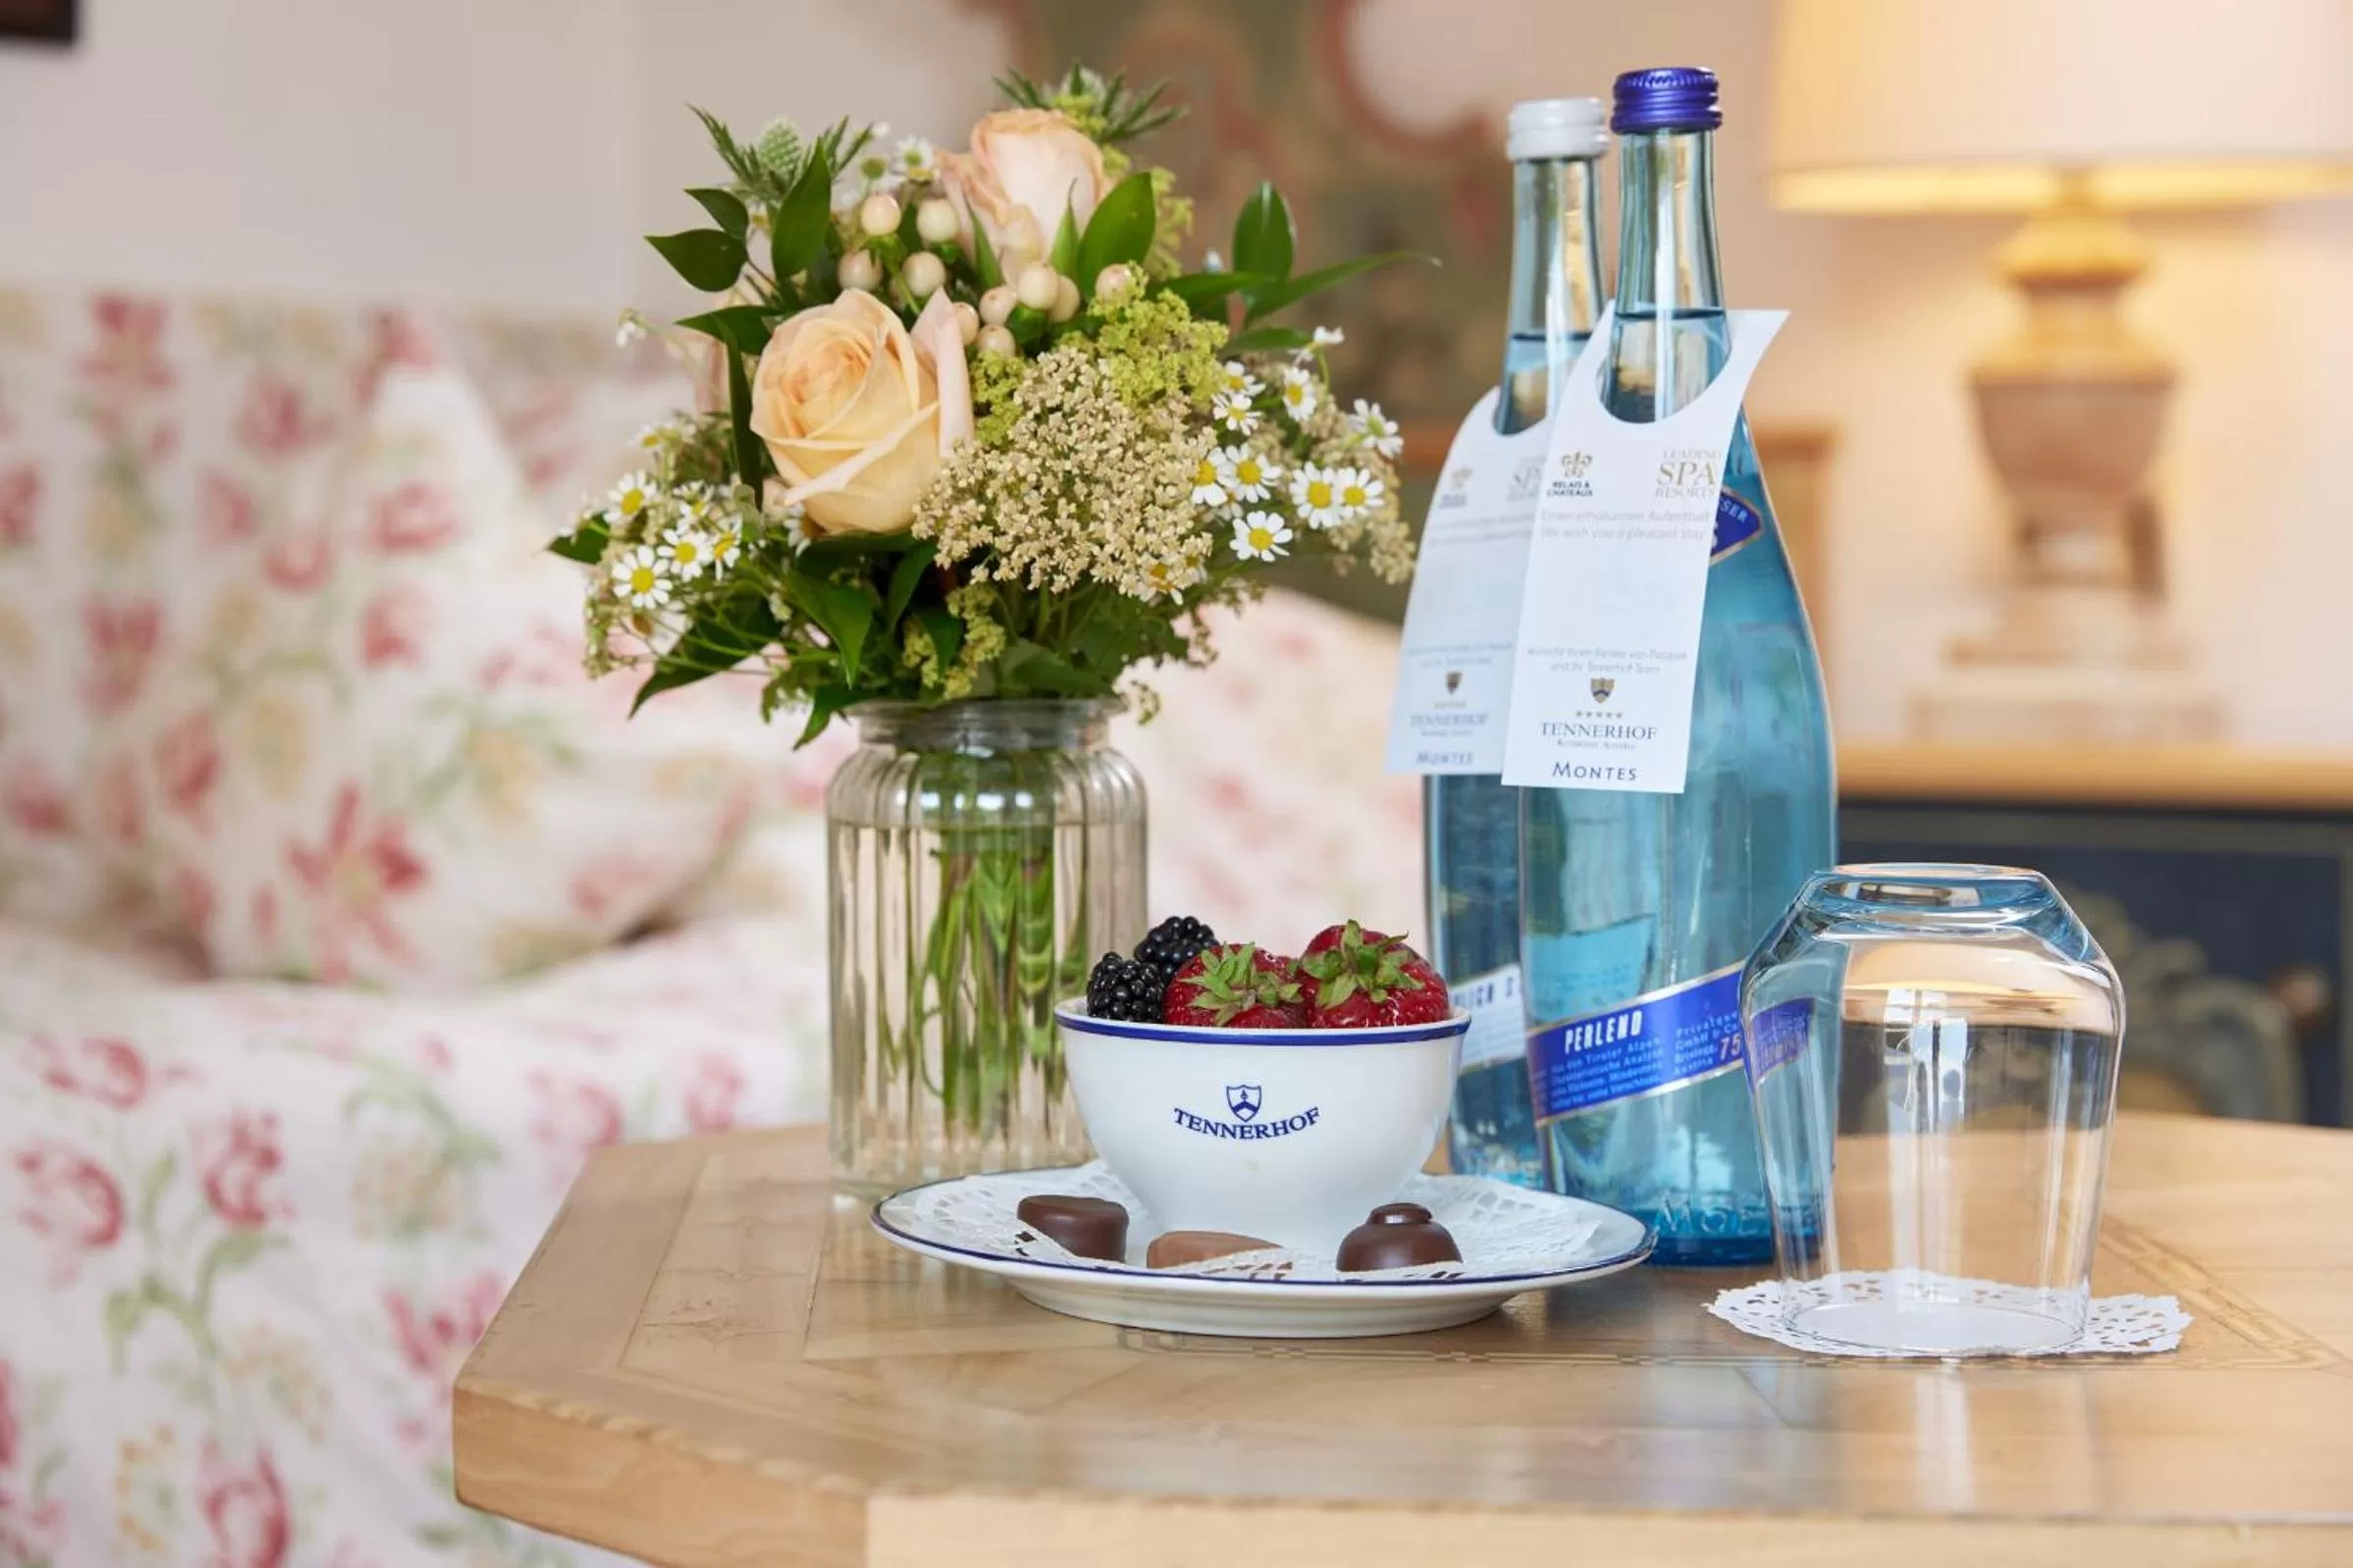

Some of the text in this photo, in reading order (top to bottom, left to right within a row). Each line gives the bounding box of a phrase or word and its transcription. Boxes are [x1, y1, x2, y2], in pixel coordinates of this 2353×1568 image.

[1657, 461, 1715, 485] SPA
[1540, 721, 1658, 740] TENNERHOF
[1174, 1106, 1320, 1139] TENNERHOF
